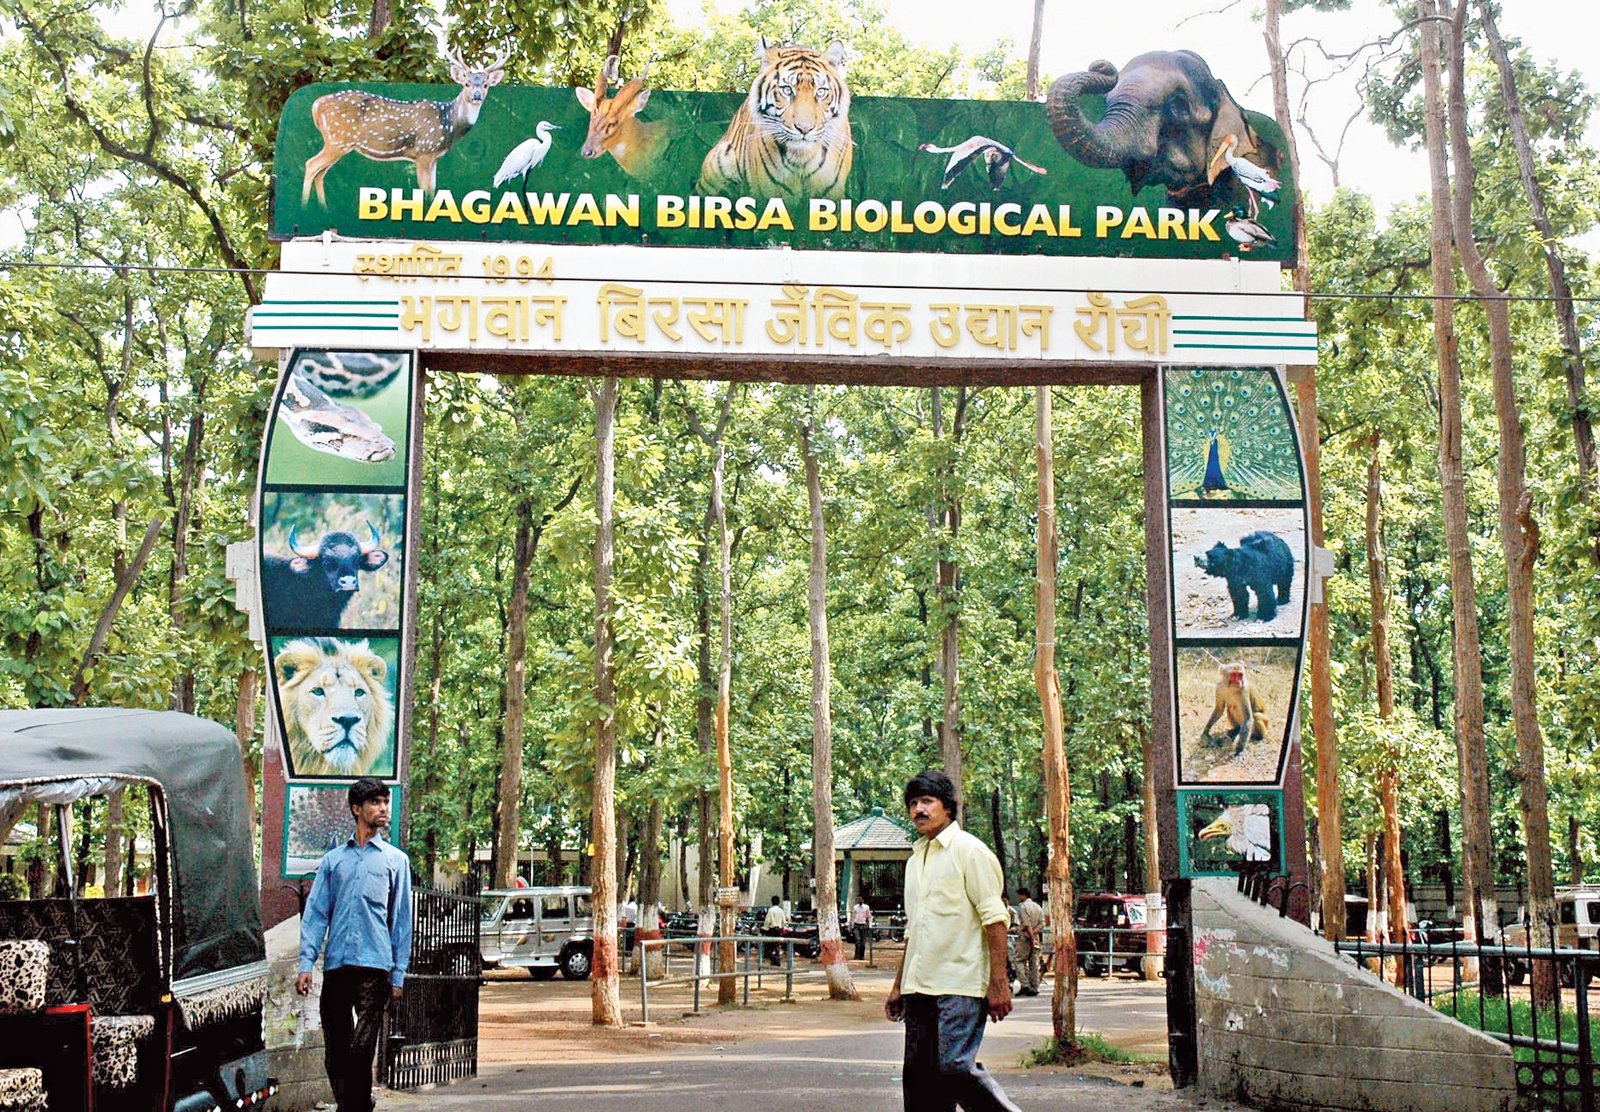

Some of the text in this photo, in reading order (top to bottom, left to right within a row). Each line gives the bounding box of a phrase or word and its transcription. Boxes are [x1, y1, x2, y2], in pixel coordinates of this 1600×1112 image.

[358, 187, 1221, 242] BHAGAWAN BIRSA BIOLOGICAL PARK
[353, 243, 555, 284] स्थापित 1994
[400, 295, 568, 341] भगवान
[597, 283, 749, 343] बिरसा
[765, 279, 912, 347] जैविक
[929, 303, 1054, 351] उद्यान
